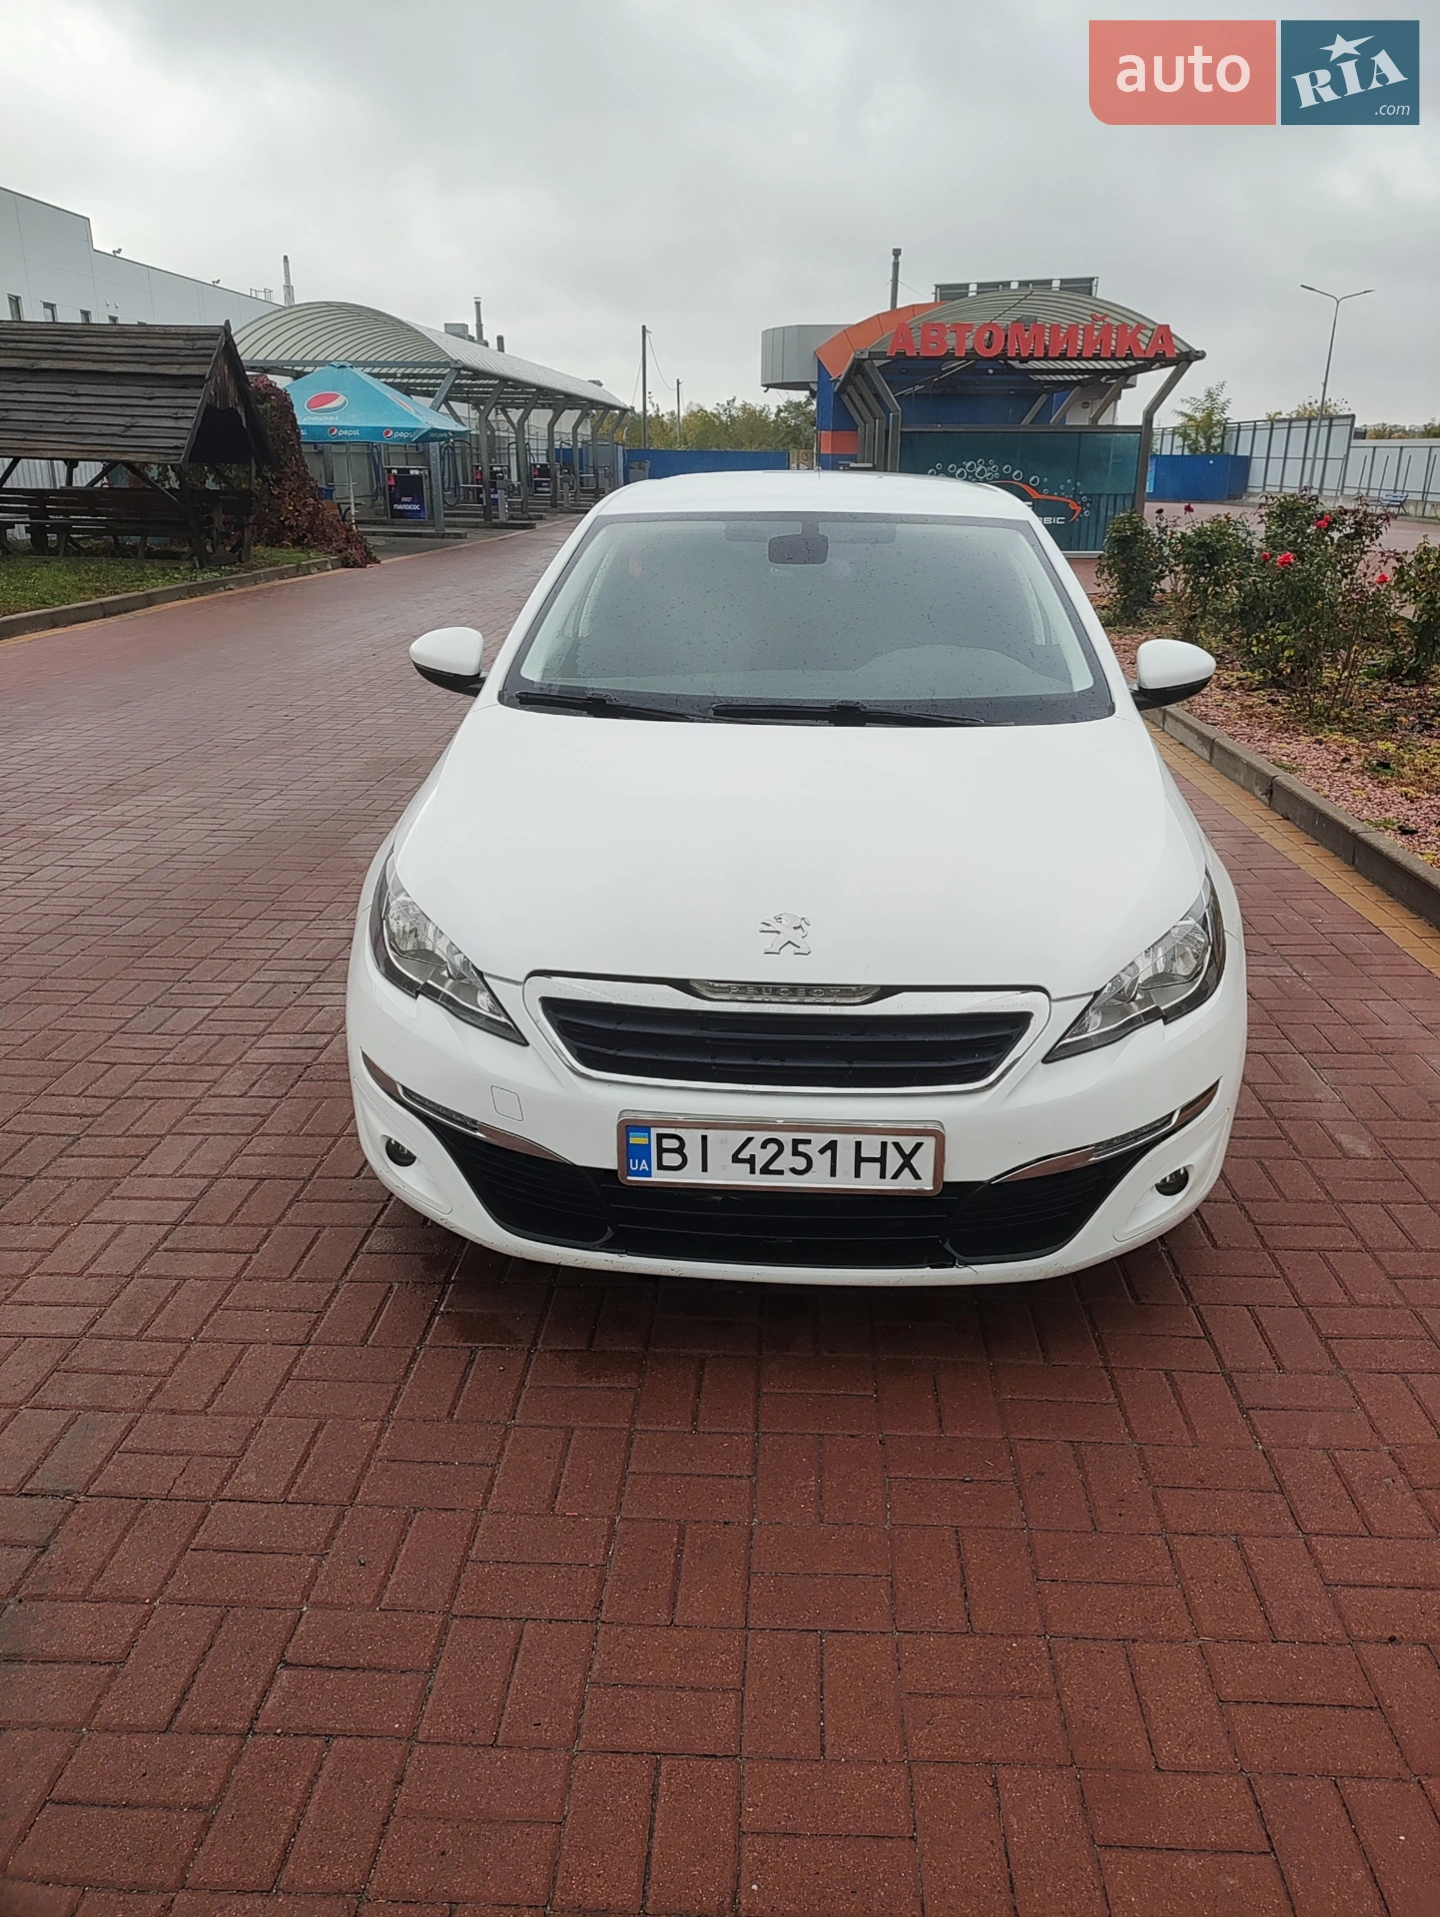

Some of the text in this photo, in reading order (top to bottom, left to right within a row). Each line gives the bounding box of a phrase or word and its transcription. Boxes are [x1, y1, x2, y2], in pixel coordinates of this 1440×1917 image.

[886, 313, 1177, 358] АВТОМИЙКА
[338, 428, 361, 437] pepsi
[728, 985, 841, 997] PEUGEOT
[629, 1159, 649, 1172] UA
